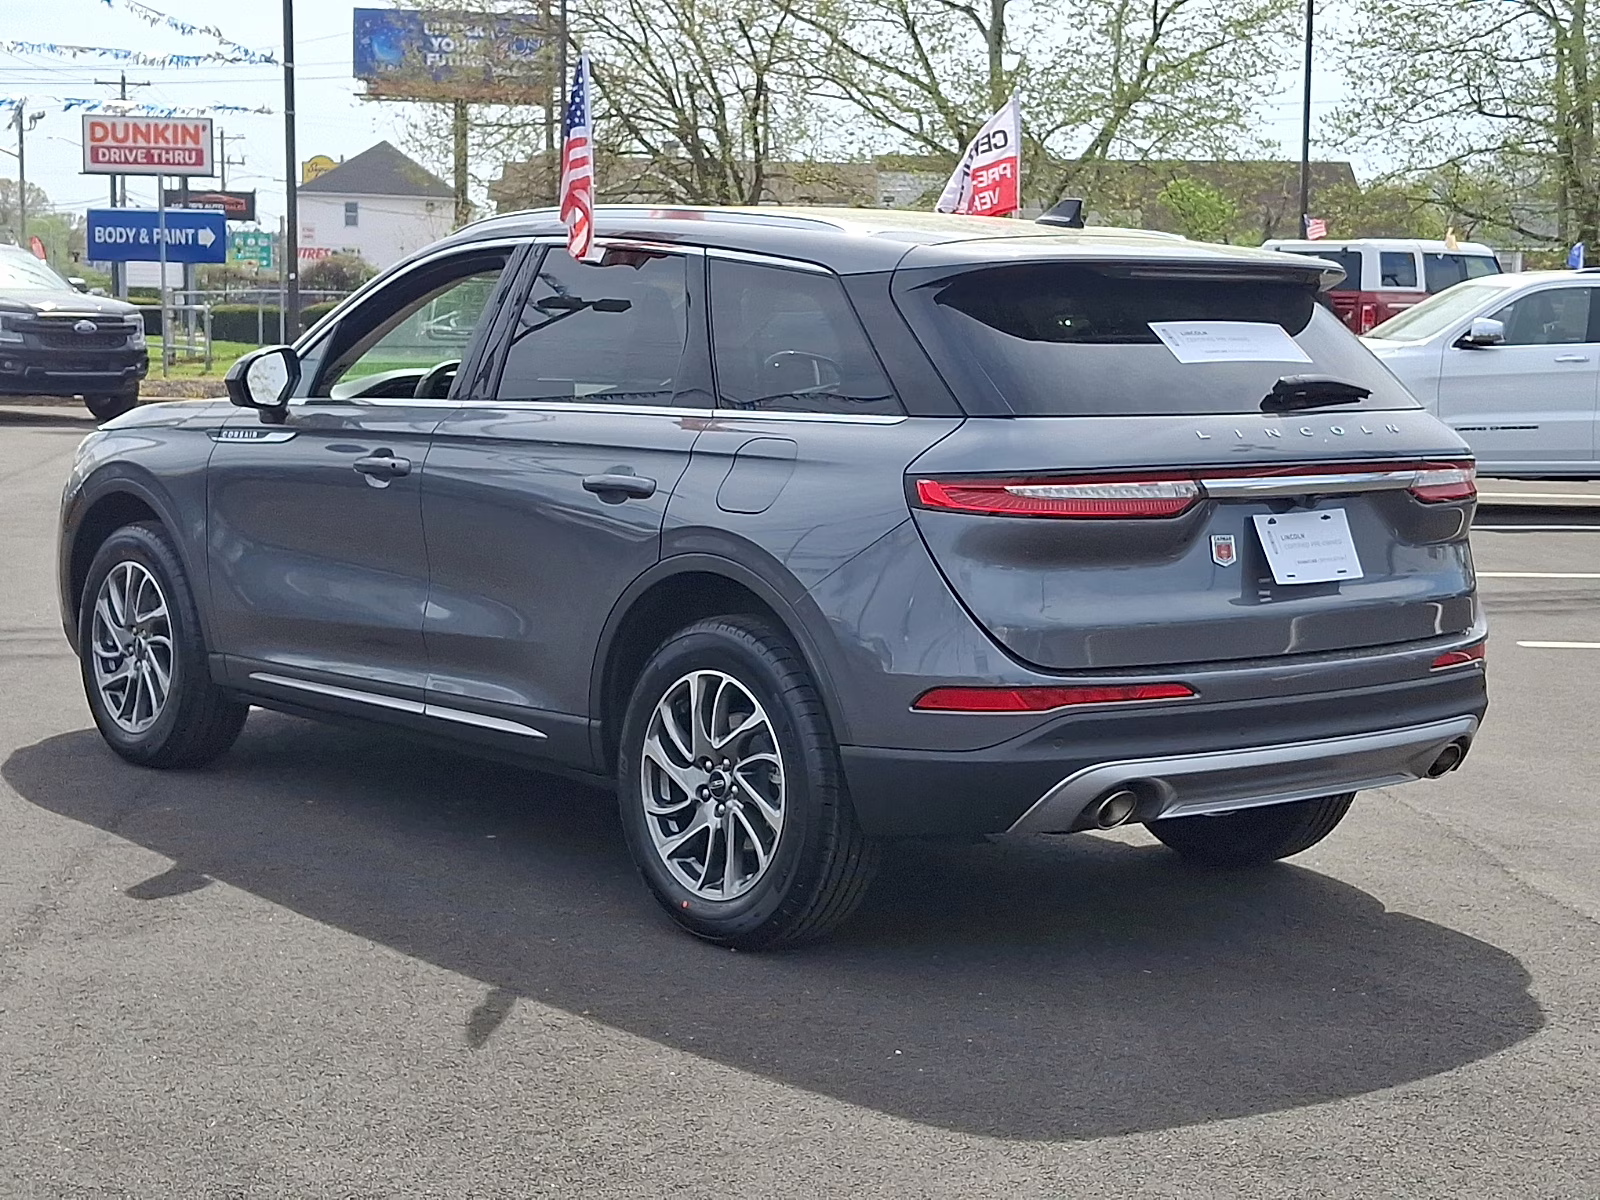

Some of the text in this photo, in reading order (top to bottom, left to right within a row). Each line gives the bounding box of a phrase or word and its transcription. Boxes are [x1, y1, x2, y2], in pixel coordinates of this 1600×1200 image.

[89, 121, 208, 145] DUNKIN'
[98, 148, 196, 164] DRIVE THRU
[94, 226, 195, 245] BODY & PAINT
[1195, 423, 1400, 440] LINCOLN
[1280, 532, 1305, 541] LINCOLN
